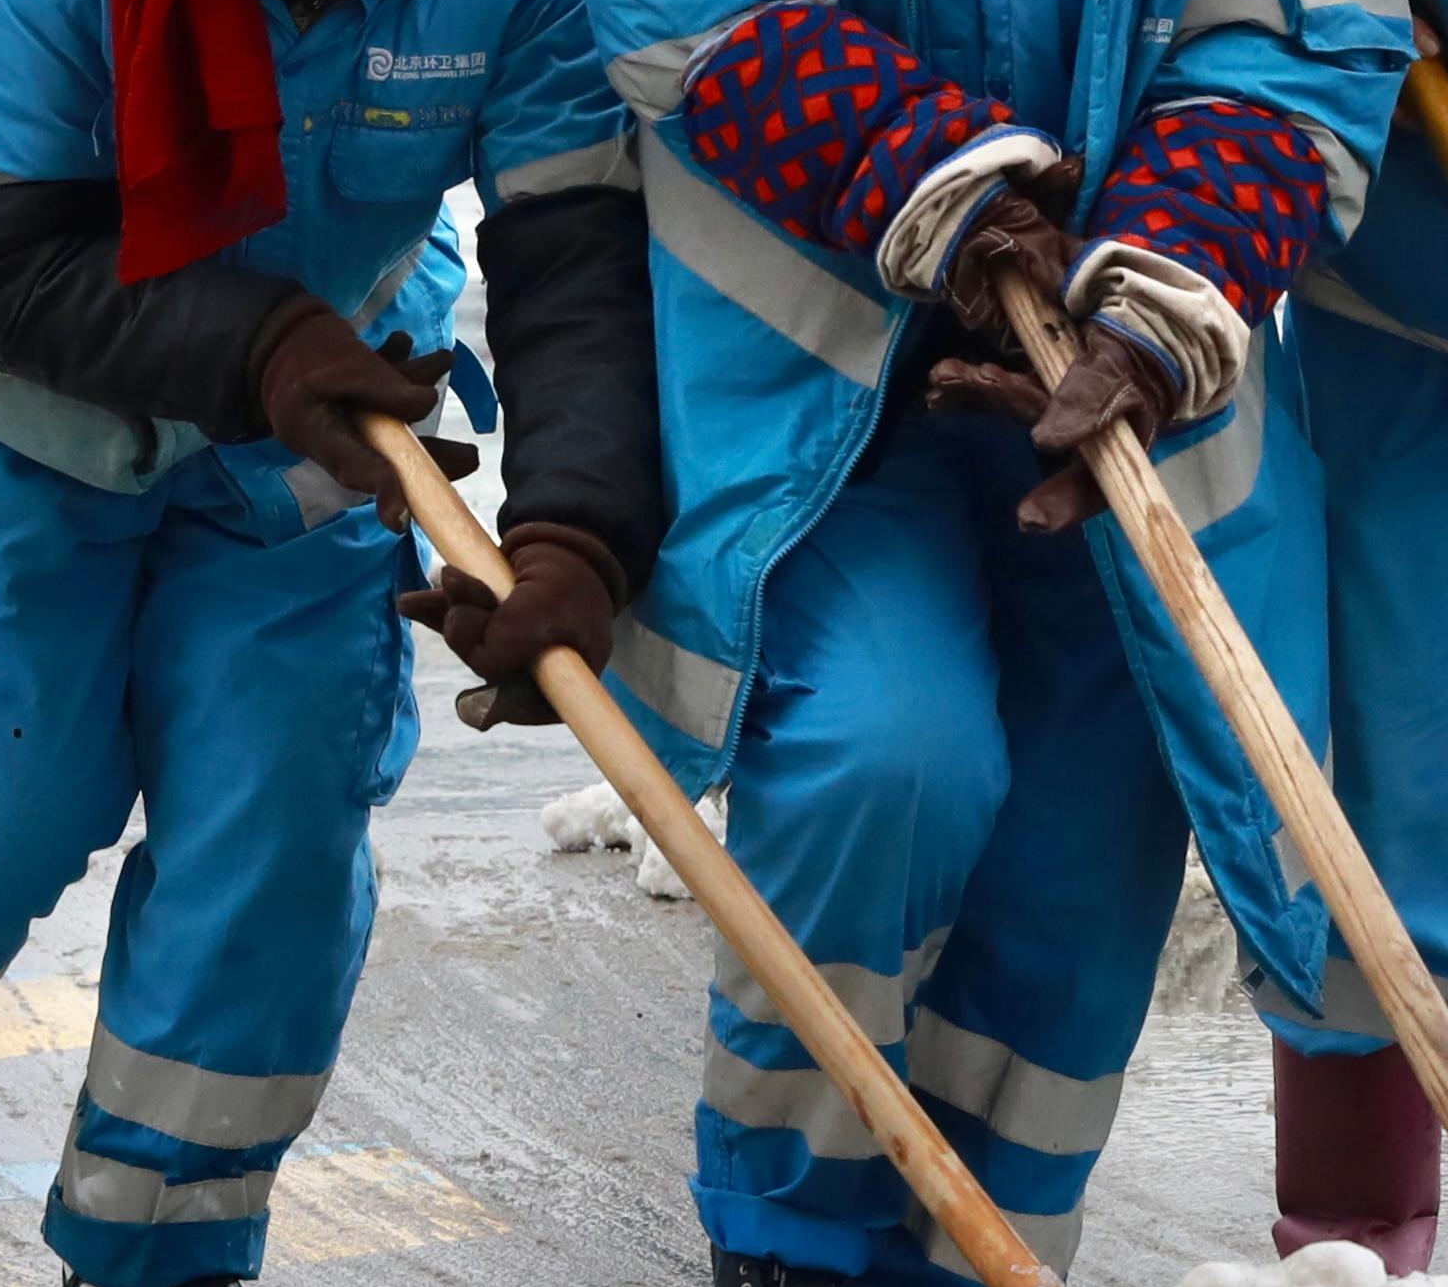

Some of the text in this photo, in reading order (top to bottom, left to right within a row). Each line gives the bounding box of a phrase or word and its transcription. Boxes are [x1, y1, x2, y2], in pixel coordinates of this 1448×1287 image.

[393, 52, 486, 70] 北京环卫集团
